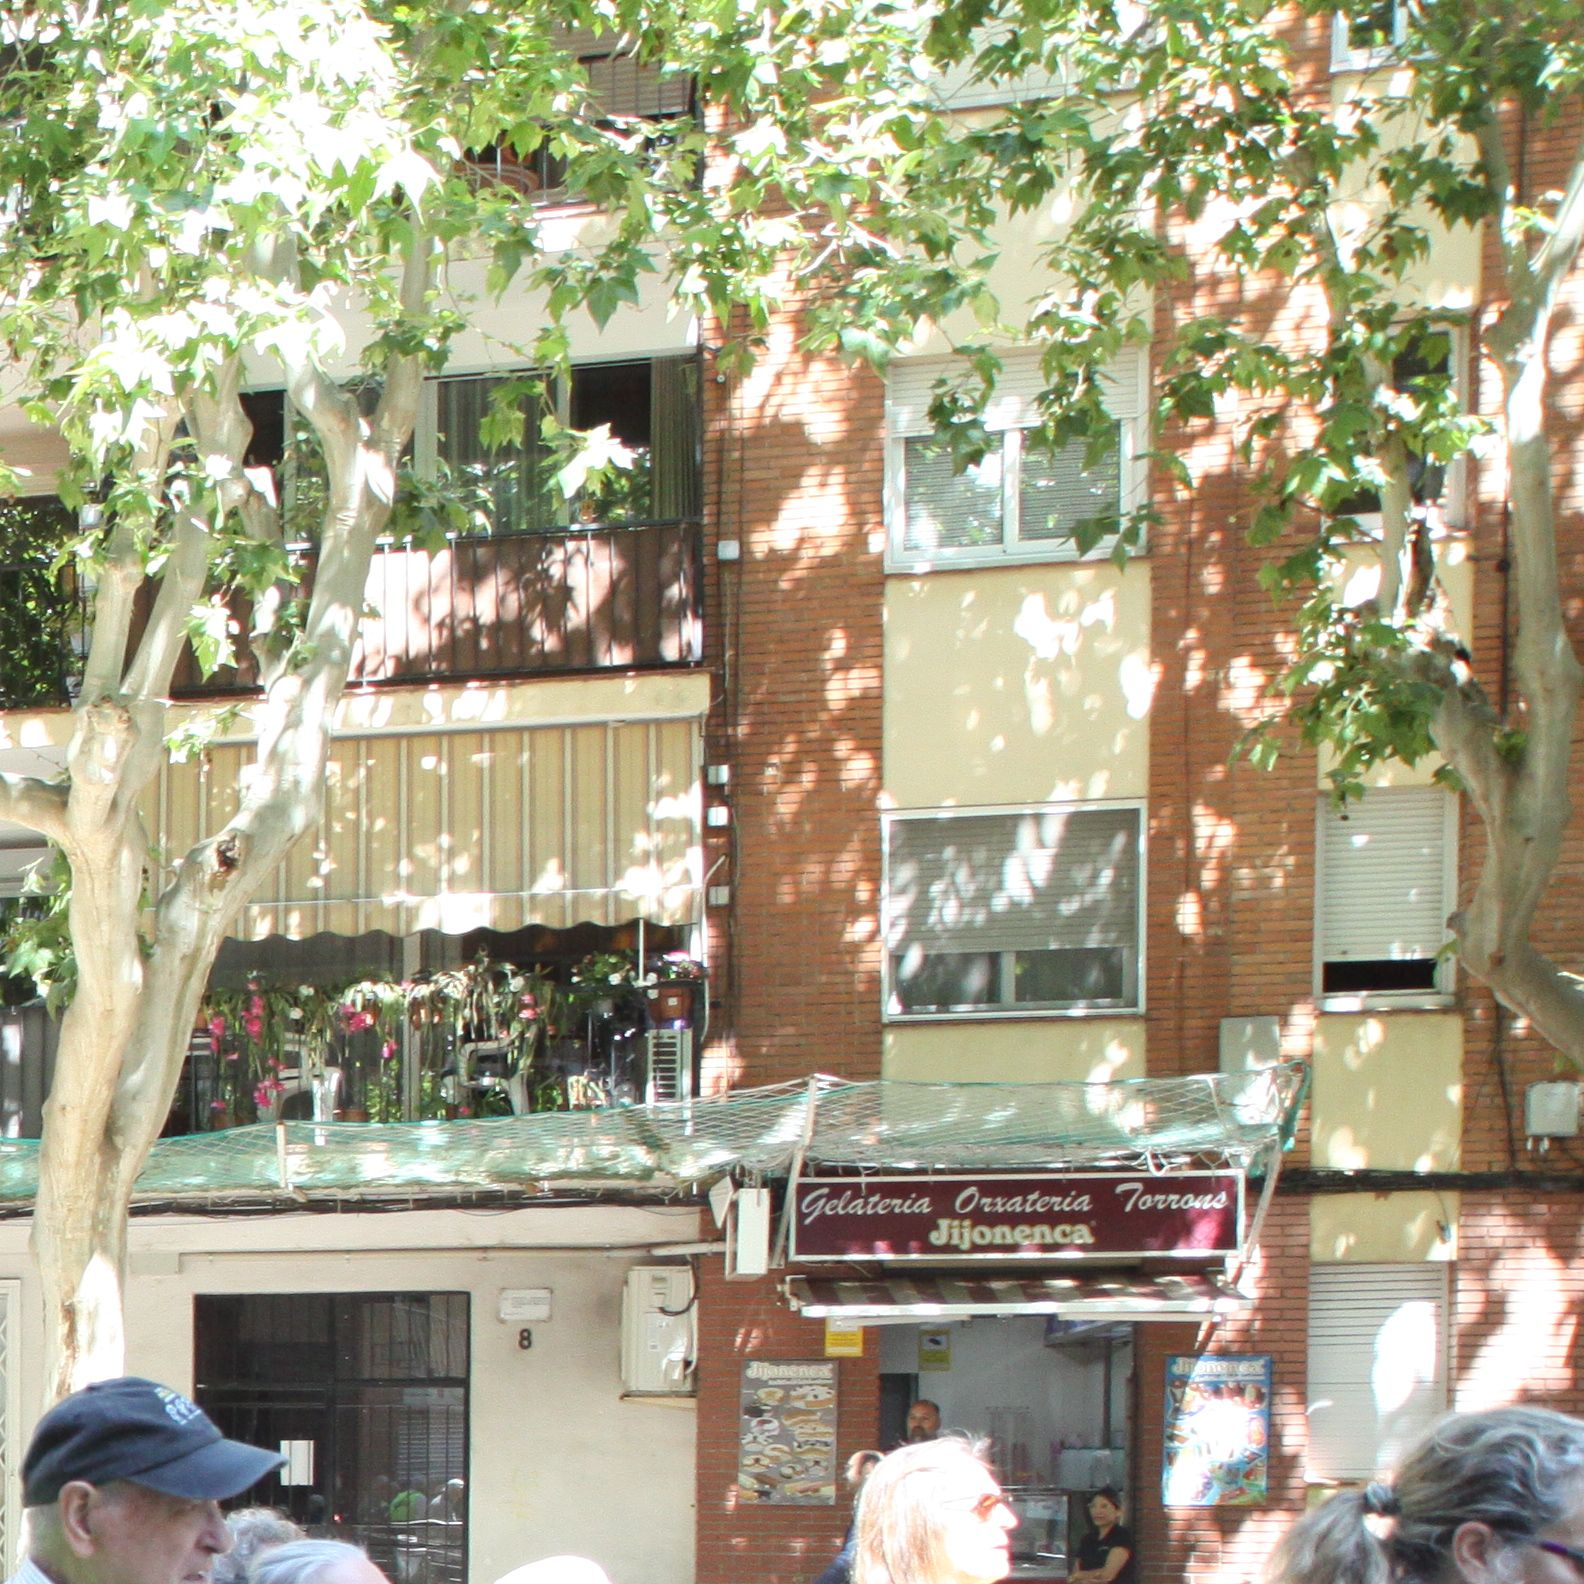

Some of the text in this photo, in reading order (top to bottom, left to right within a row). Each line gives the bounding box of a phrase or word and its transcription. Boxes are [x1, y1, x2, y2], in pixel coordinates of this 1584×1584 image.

[800, 1181, 1229, 1225] Gelateria Orxateria Torrons
[928, 1218, 1095, 1250] Jijonenca
[518, 1328, 533, 1350] 8
